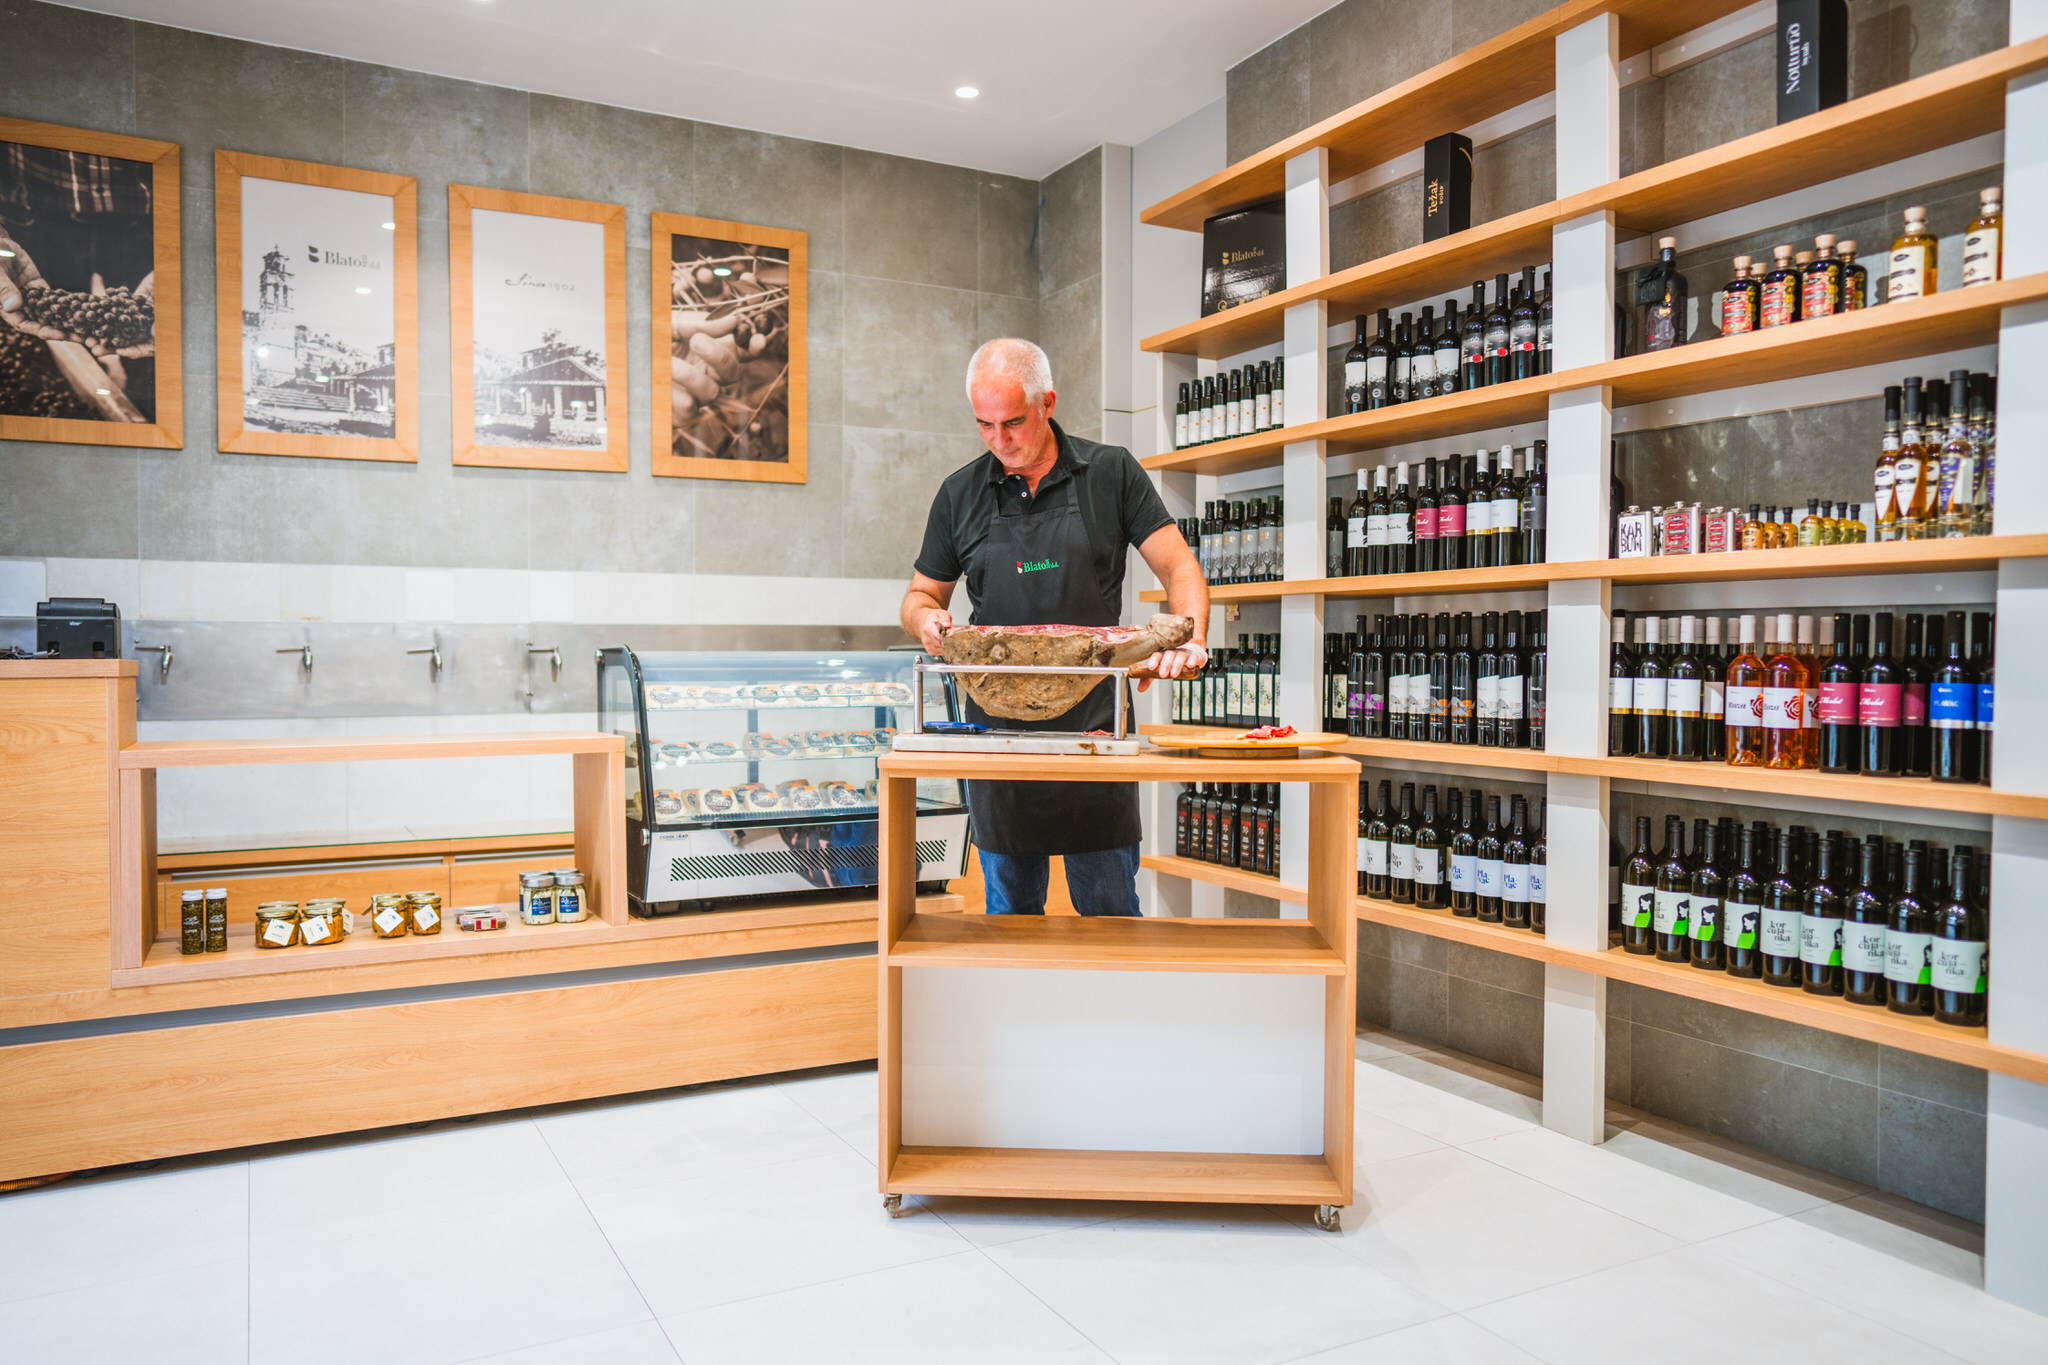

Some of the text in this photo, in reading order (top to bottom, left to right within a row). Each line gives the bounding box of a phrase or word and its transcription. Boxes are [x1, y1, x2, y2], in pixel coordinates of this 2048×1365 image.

[1785, 22, 1801, 95] Notturno
[1428, 177, 1438, 217] Težak
[325, 250, 362, 268] Blato
